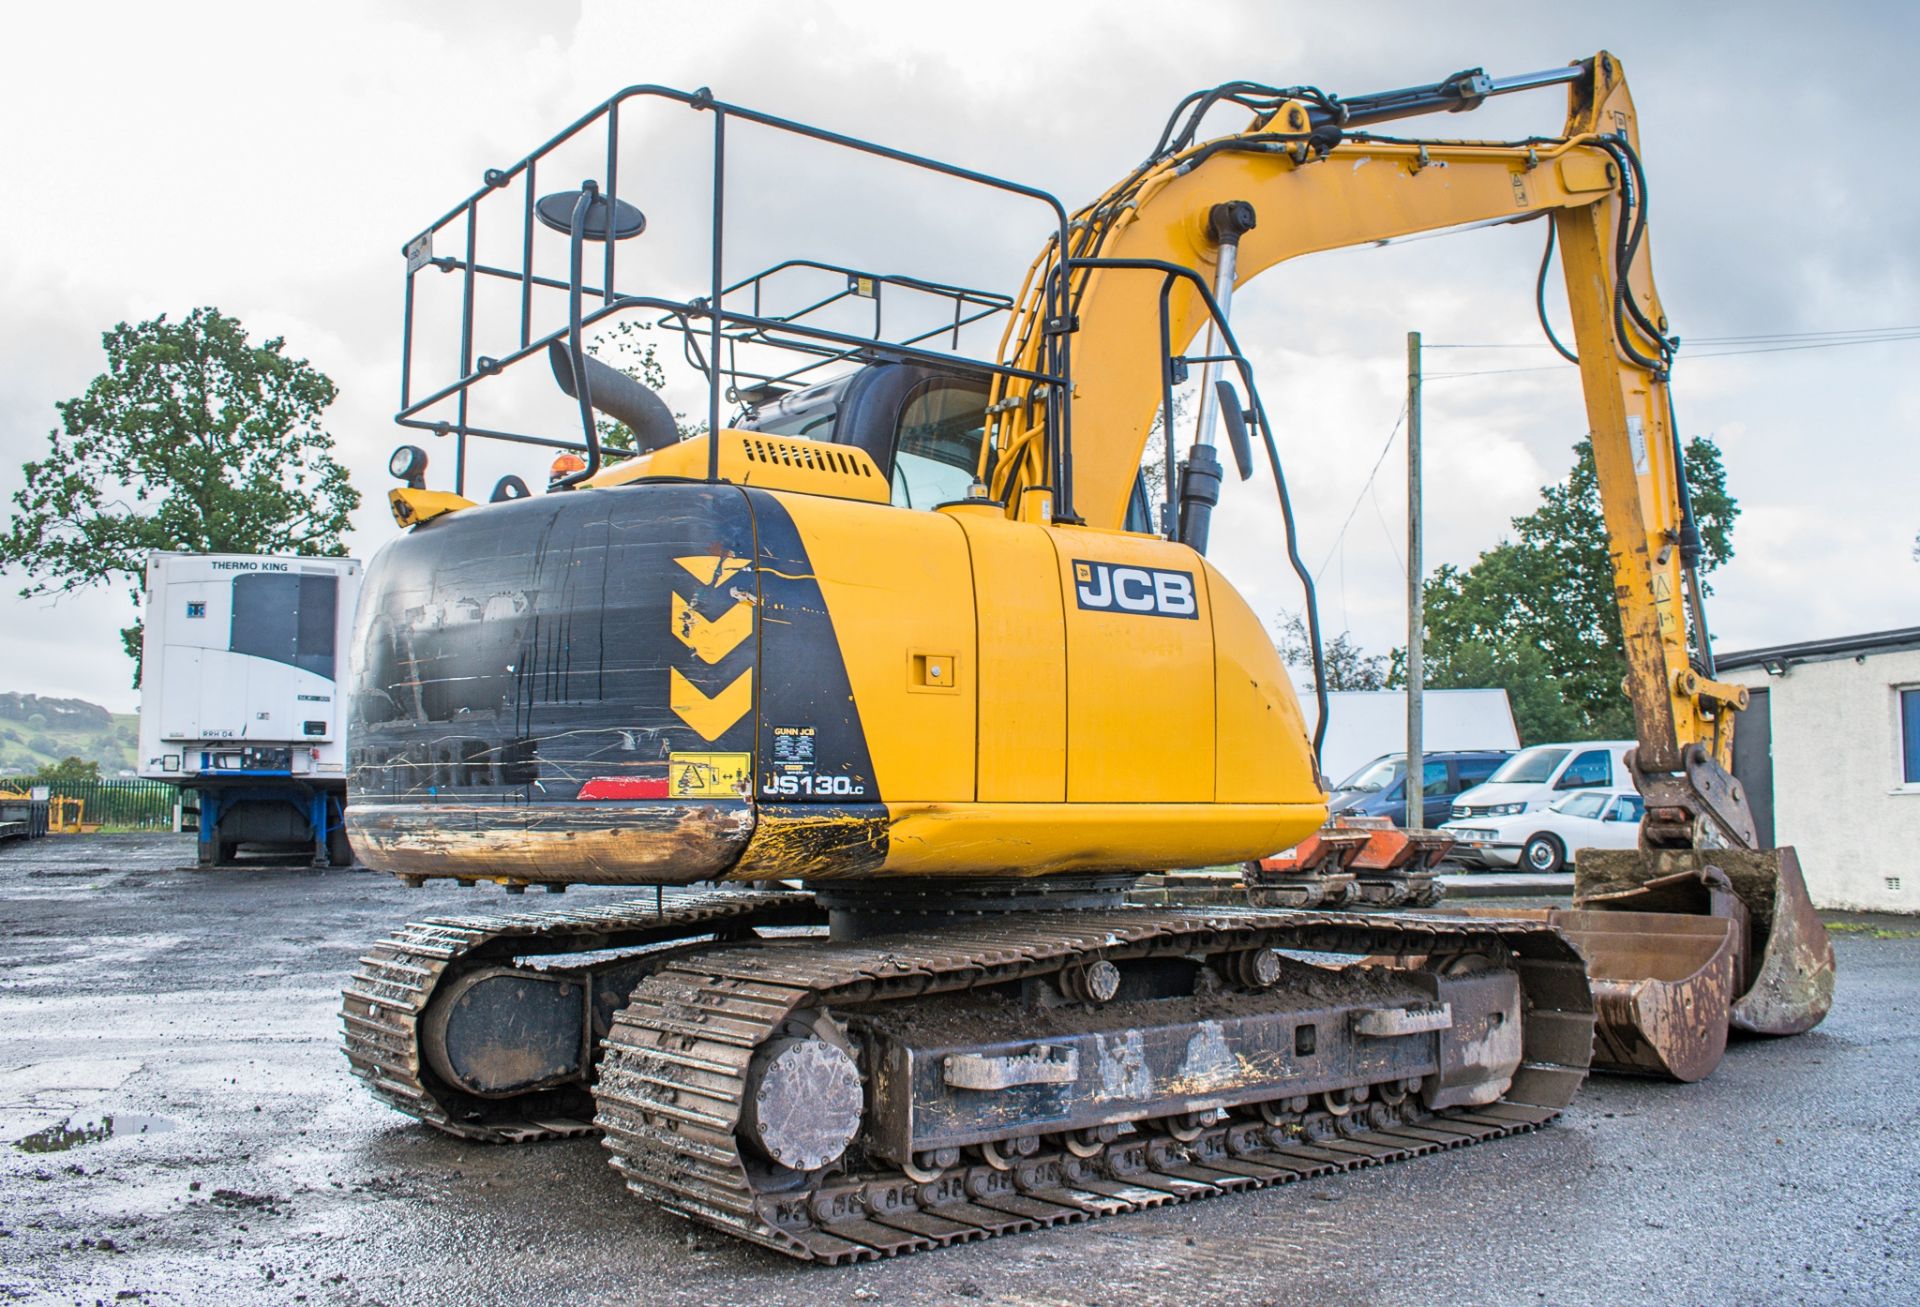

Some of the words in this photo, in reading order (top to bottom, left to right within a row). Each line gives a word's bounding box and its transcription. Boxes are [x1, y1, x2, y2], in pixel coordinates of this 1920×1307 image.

[212, 561, 257, 570] THERMO
[262, 562, 288, 571] KING
[1079, 565, 1195, 614] JCB
[800, 728, 815, 736] JCB
